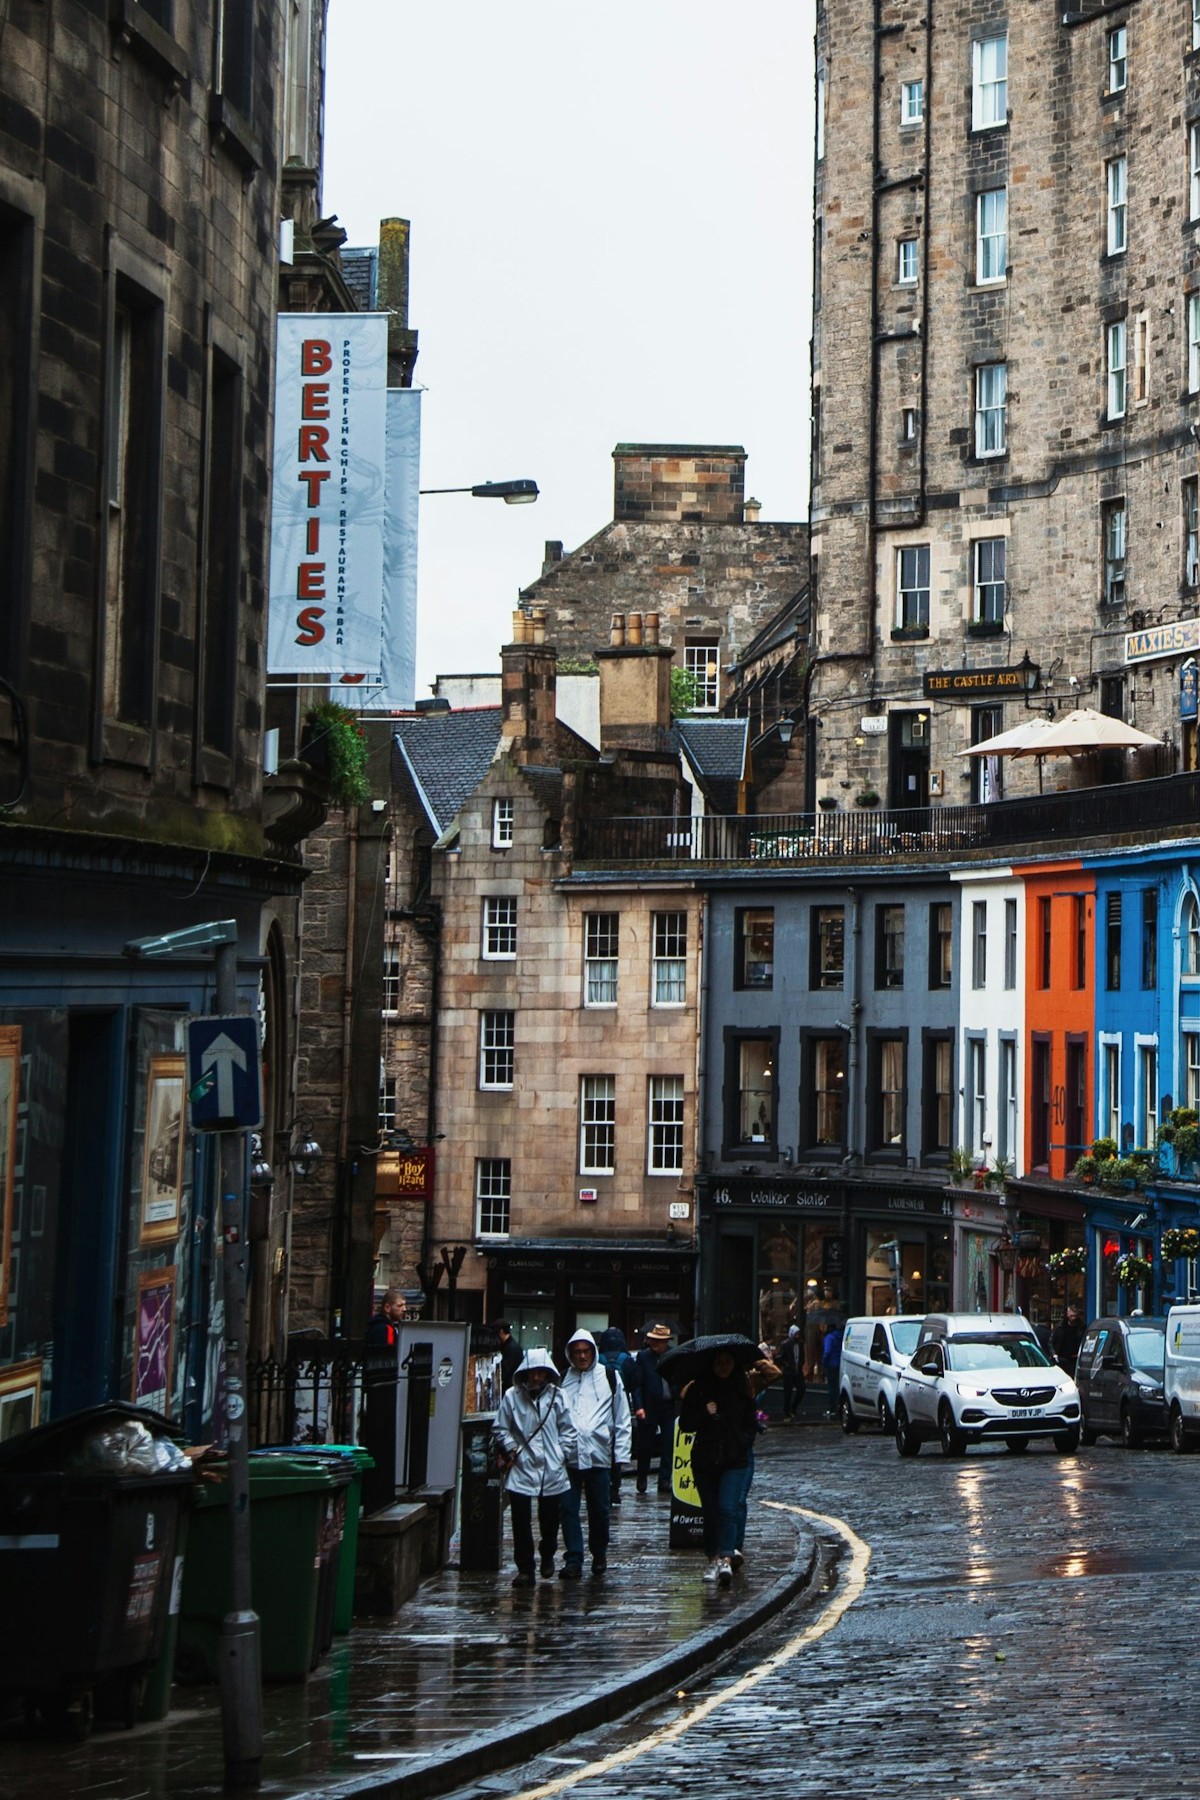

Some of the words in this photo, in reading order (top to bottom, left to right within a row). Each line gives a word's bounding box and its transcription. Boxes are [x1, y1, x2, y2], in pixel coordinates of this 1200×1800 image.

[342, 340, 351, 394] PROPER
[341, 398, 349, 434] FISH
[339, 449, 348, 495] CHIPS
[295, 339, 332, 647] BERTIES
[337, 510, 347, 603] RESTAURANT
[335, 618, 344, 645] BAR
[1128, 626, 1185, 656] MAXIES
[928, 677, 950, 689] THE
[954, 674, 994, 687] CASTLE
[997, 672, 1017, 685] AR
[405, 1161, 425, 1176] Boy
[750, 1191, 790, 1205] Walker
[797, 1191, 830, 1206] Slater
